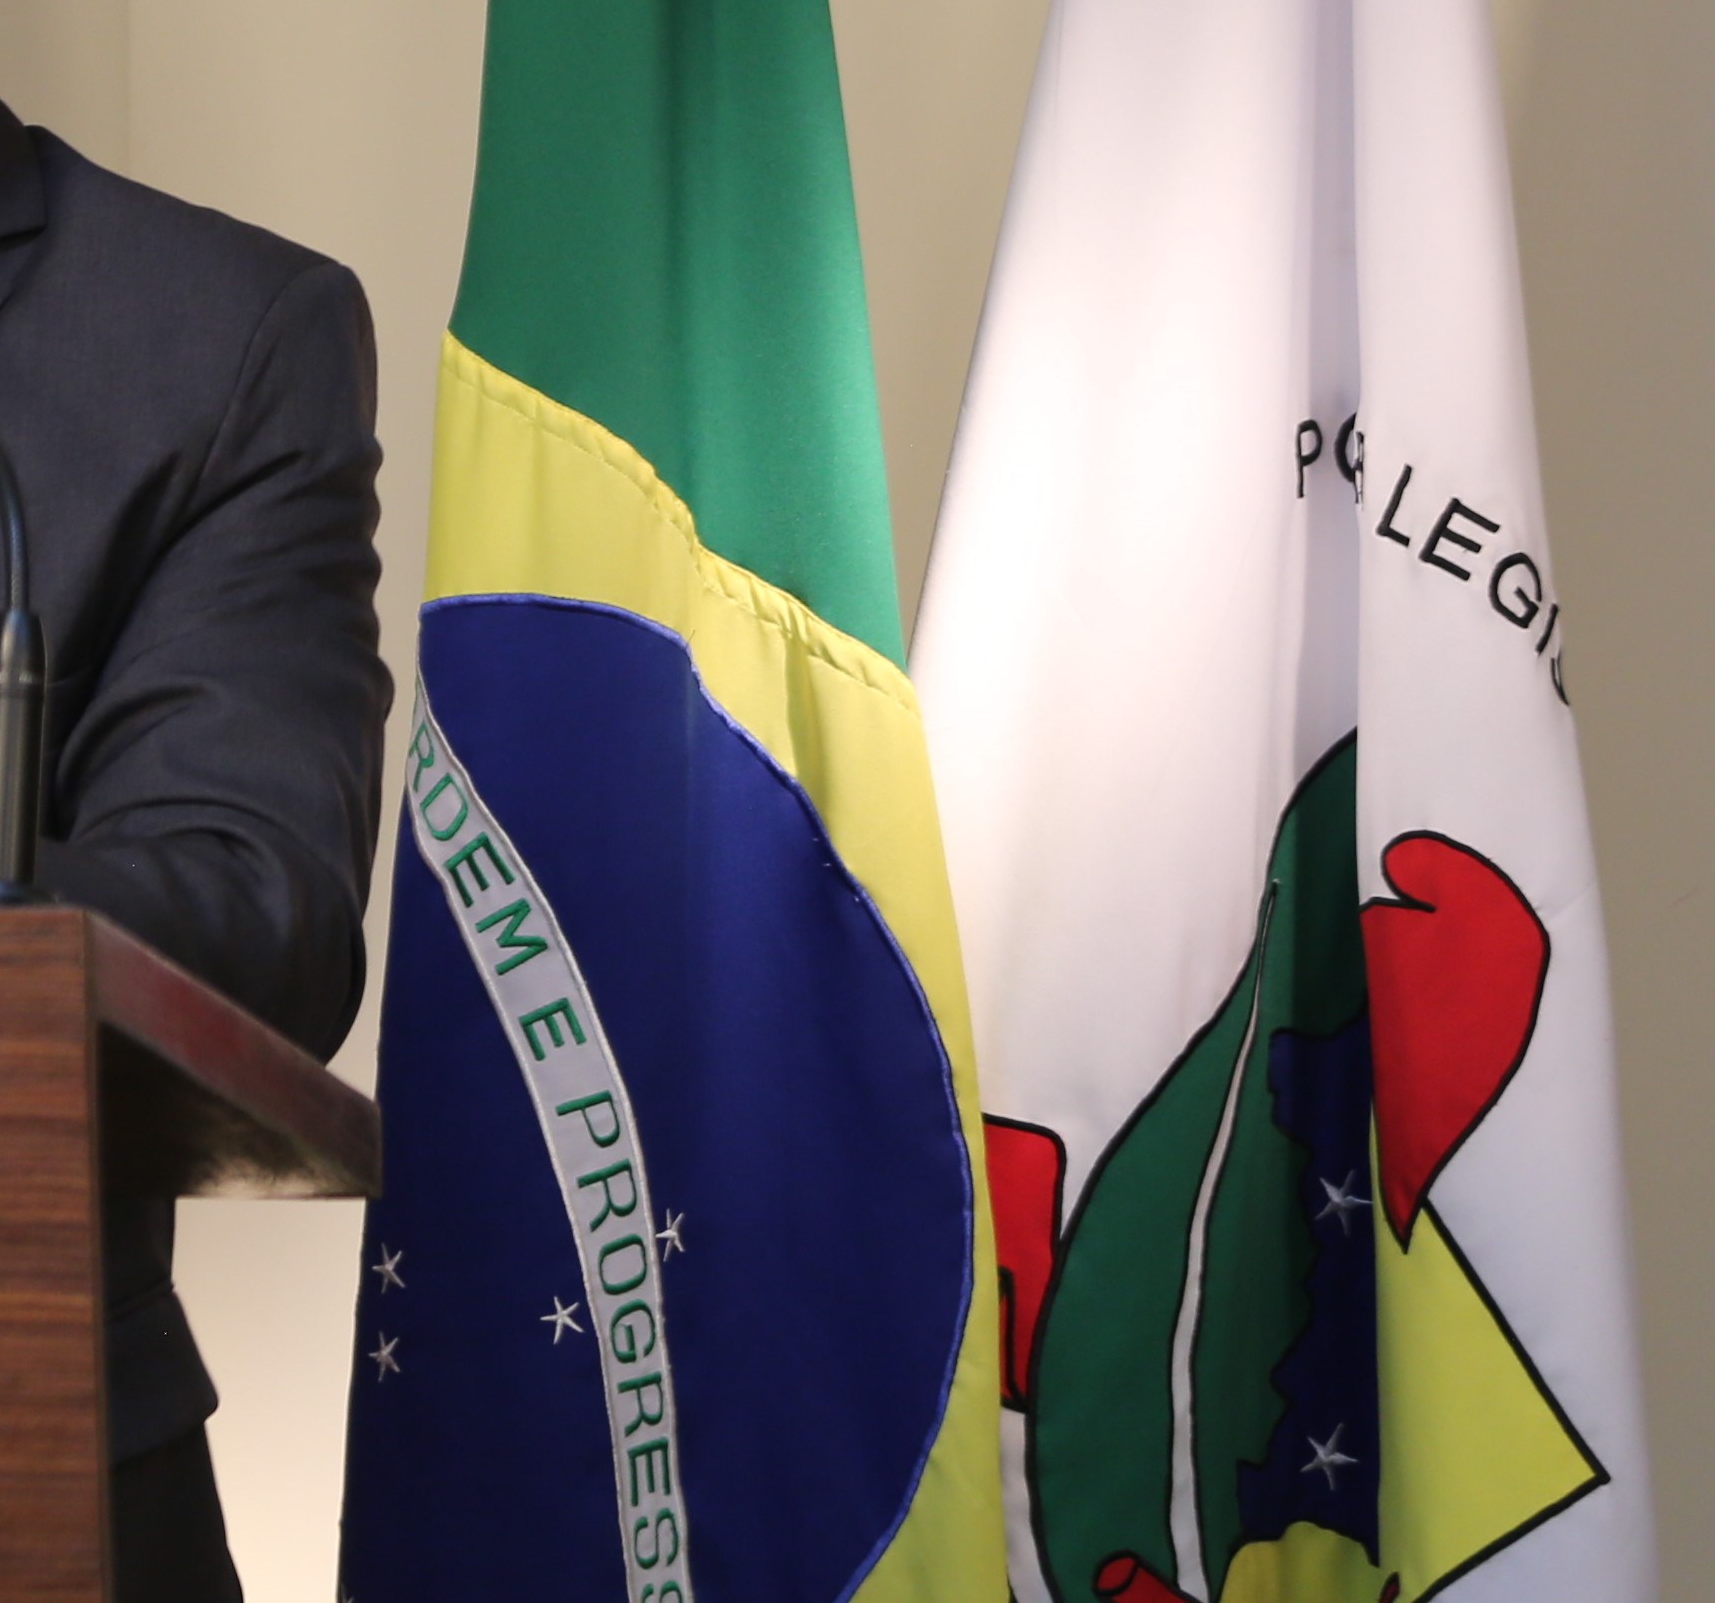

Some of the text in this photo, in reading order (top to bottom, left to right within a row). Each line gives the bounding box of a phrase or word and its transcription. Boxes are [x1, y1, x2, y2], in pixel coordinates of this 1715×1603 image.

[1375, 462, 1570, 706] LEGI
[408, 675, 549, 977] RDEM
[518, 996, 587, 1062] E
